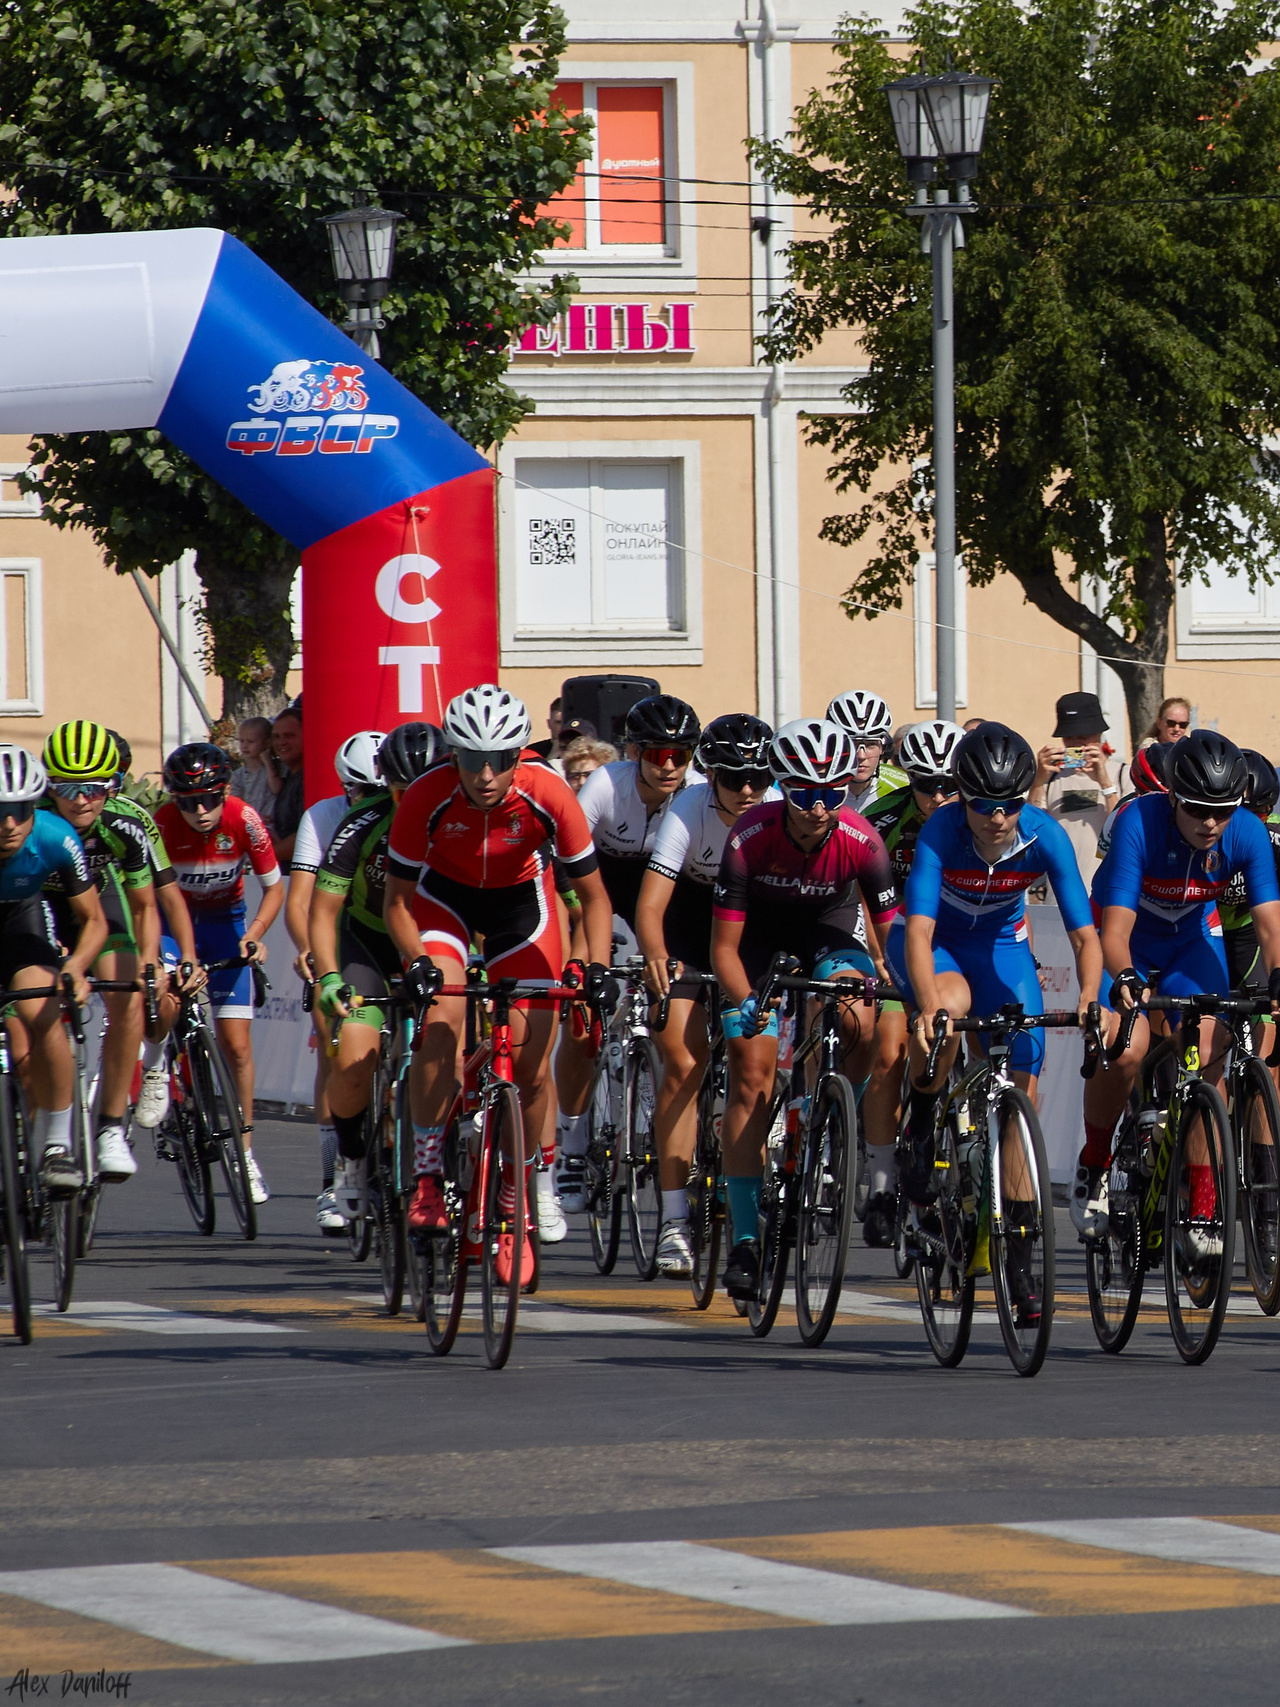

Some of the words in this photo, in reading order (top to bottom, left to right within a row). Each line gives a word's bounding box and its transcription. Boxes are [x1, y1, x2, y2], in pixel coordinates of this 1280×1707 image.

[505, 303, 695, 362] ЕНЫ
[226, 414, 400, 456] ФВСР
[605, 520, 667, 534] ПОКУПАЙ
[606, 535, 667, 550] ОНЛАЙН
[328, 810, 381, 865] MICHE
[62, 835, 89, 882] MAIKOP
[801, 884, 837, 896] VITA
[956, 877, 986, 887] СШОР
[988, 876, 1037, 888] ПЕТЕРГО
[1151, 884, 1184, 896] СШОР
[878, 886, 896, 903] BV
